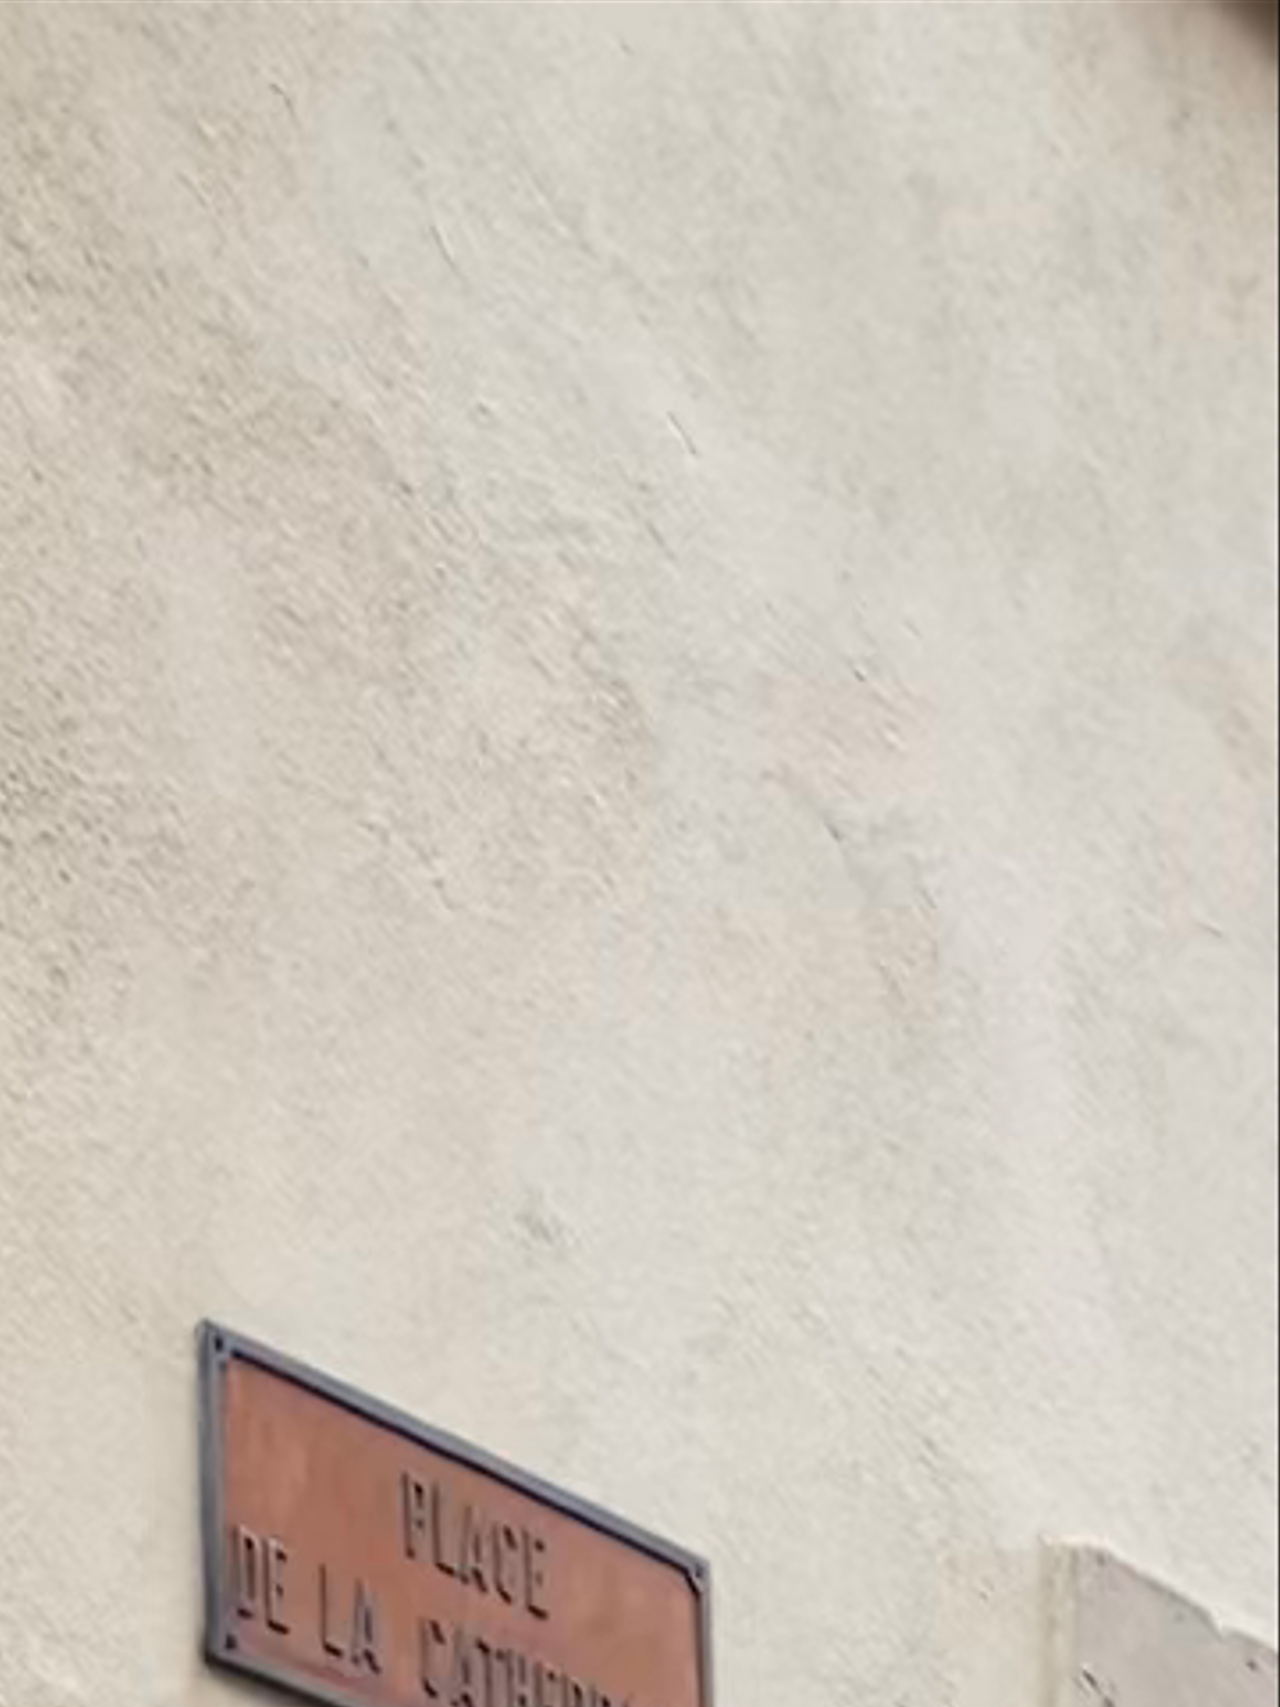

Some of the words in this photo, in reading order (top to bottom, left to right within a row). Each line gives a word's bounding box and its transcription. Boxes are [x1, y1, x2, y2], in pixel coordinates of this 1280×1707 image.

[231, 1524, 290, 1636] DE
[319, 1563, 382, 1675] LA
[401, 1471, 549, 1621] PLACE
